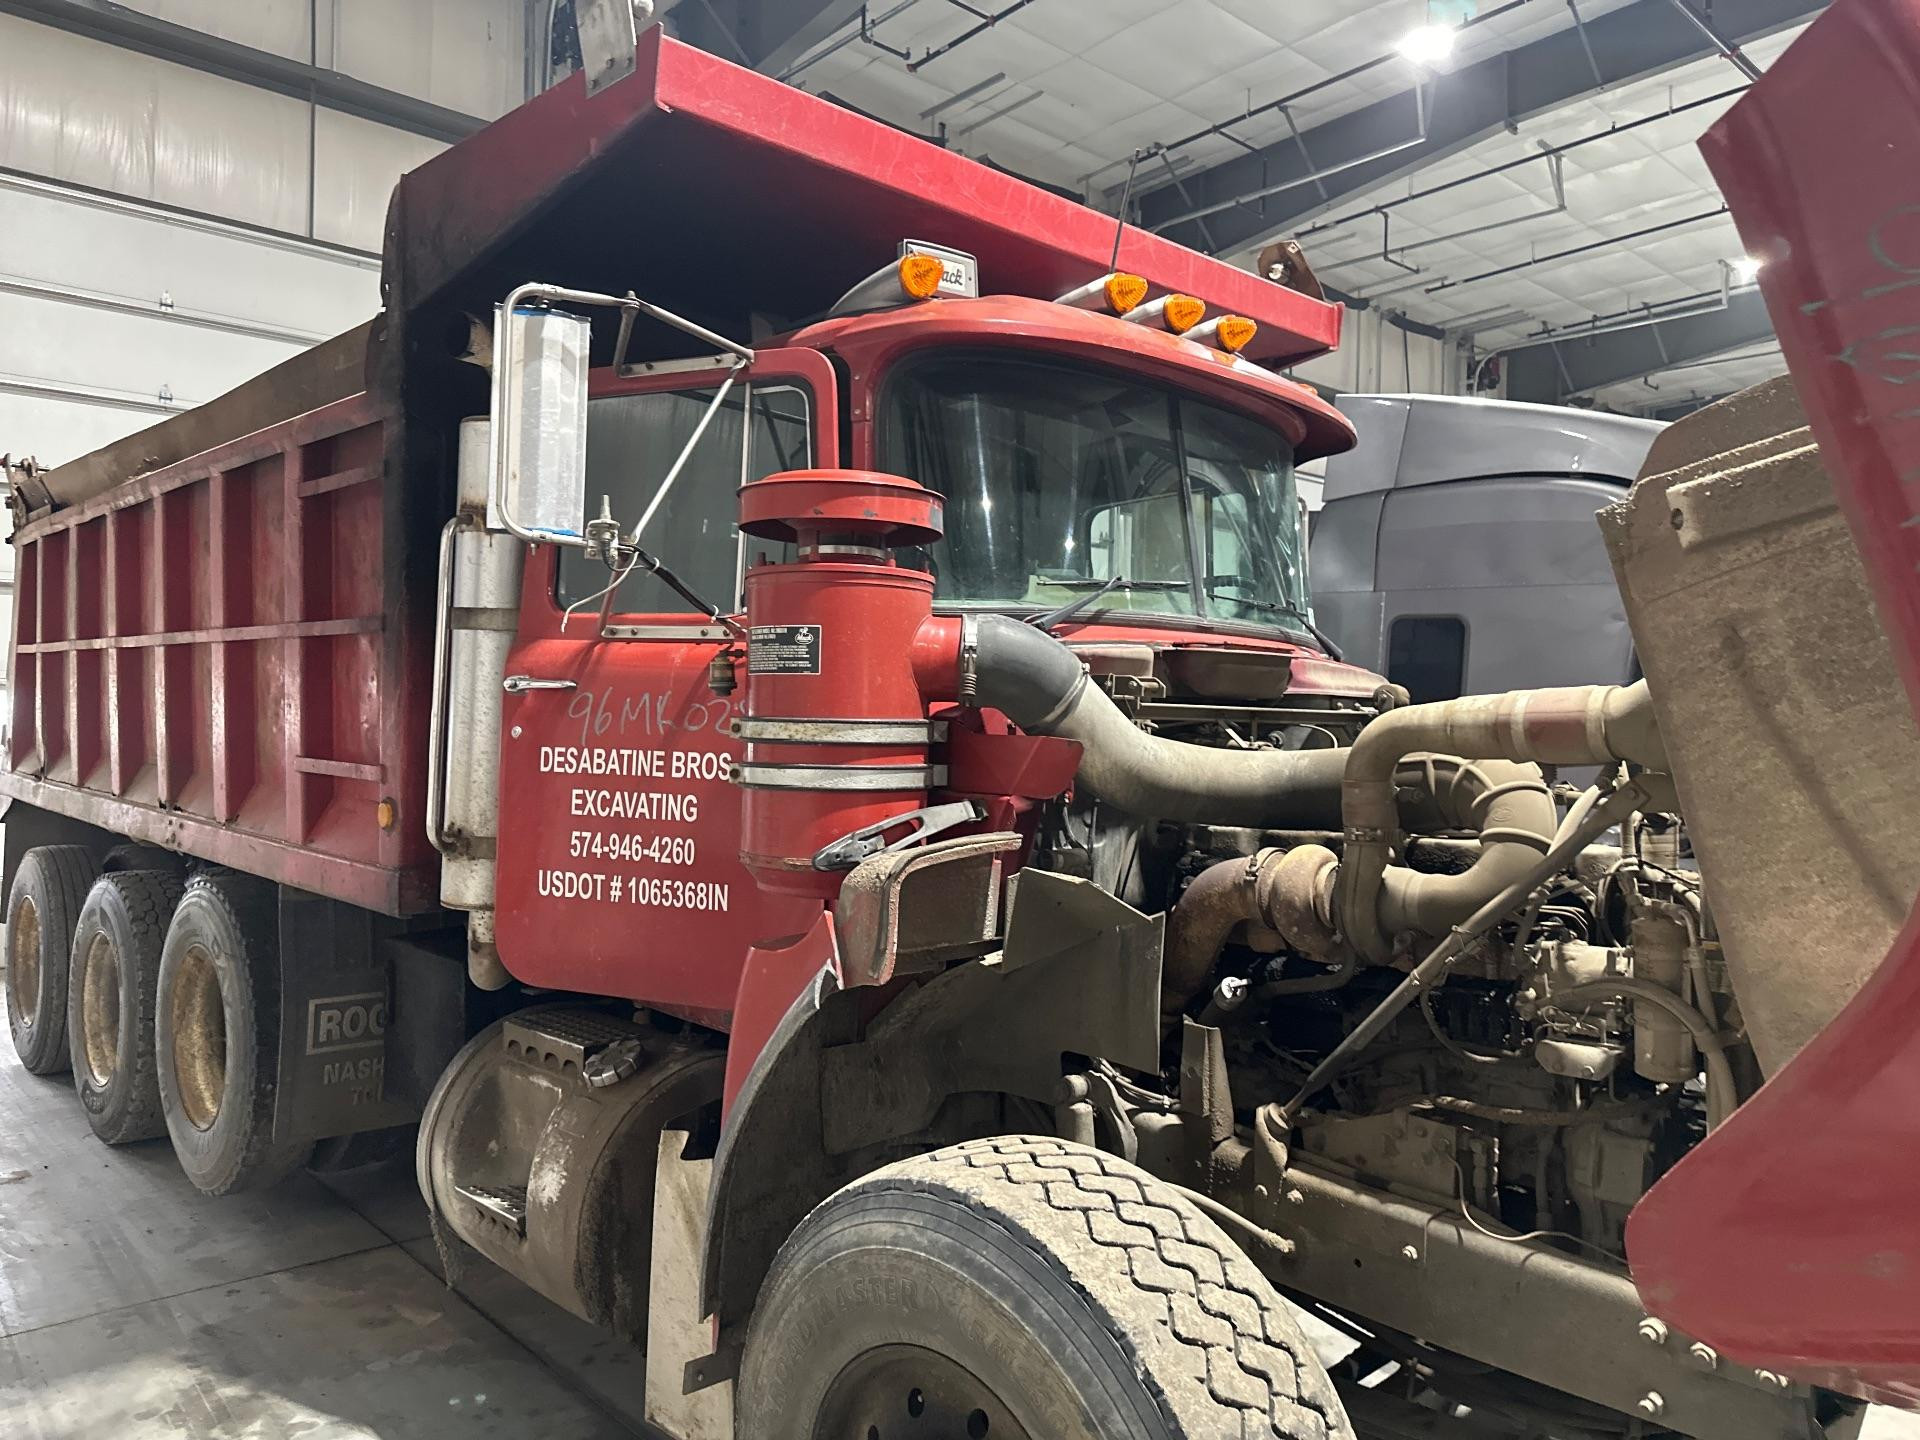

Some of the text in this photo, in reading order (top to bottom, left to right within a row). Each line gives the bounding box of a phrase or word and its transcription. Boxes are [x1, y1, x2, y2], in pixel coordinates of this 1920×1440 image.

[941, 268, 963, 286] ack
[540, 746, 733, 781] DESABATINE BROS
[571, 788, 698, 823] EXCAVATING
[570, 830, 696, 866] 574-946-4260
[538, 869, 606, 901] USDOT
[628, 876, 729, 912] 1065368IN
